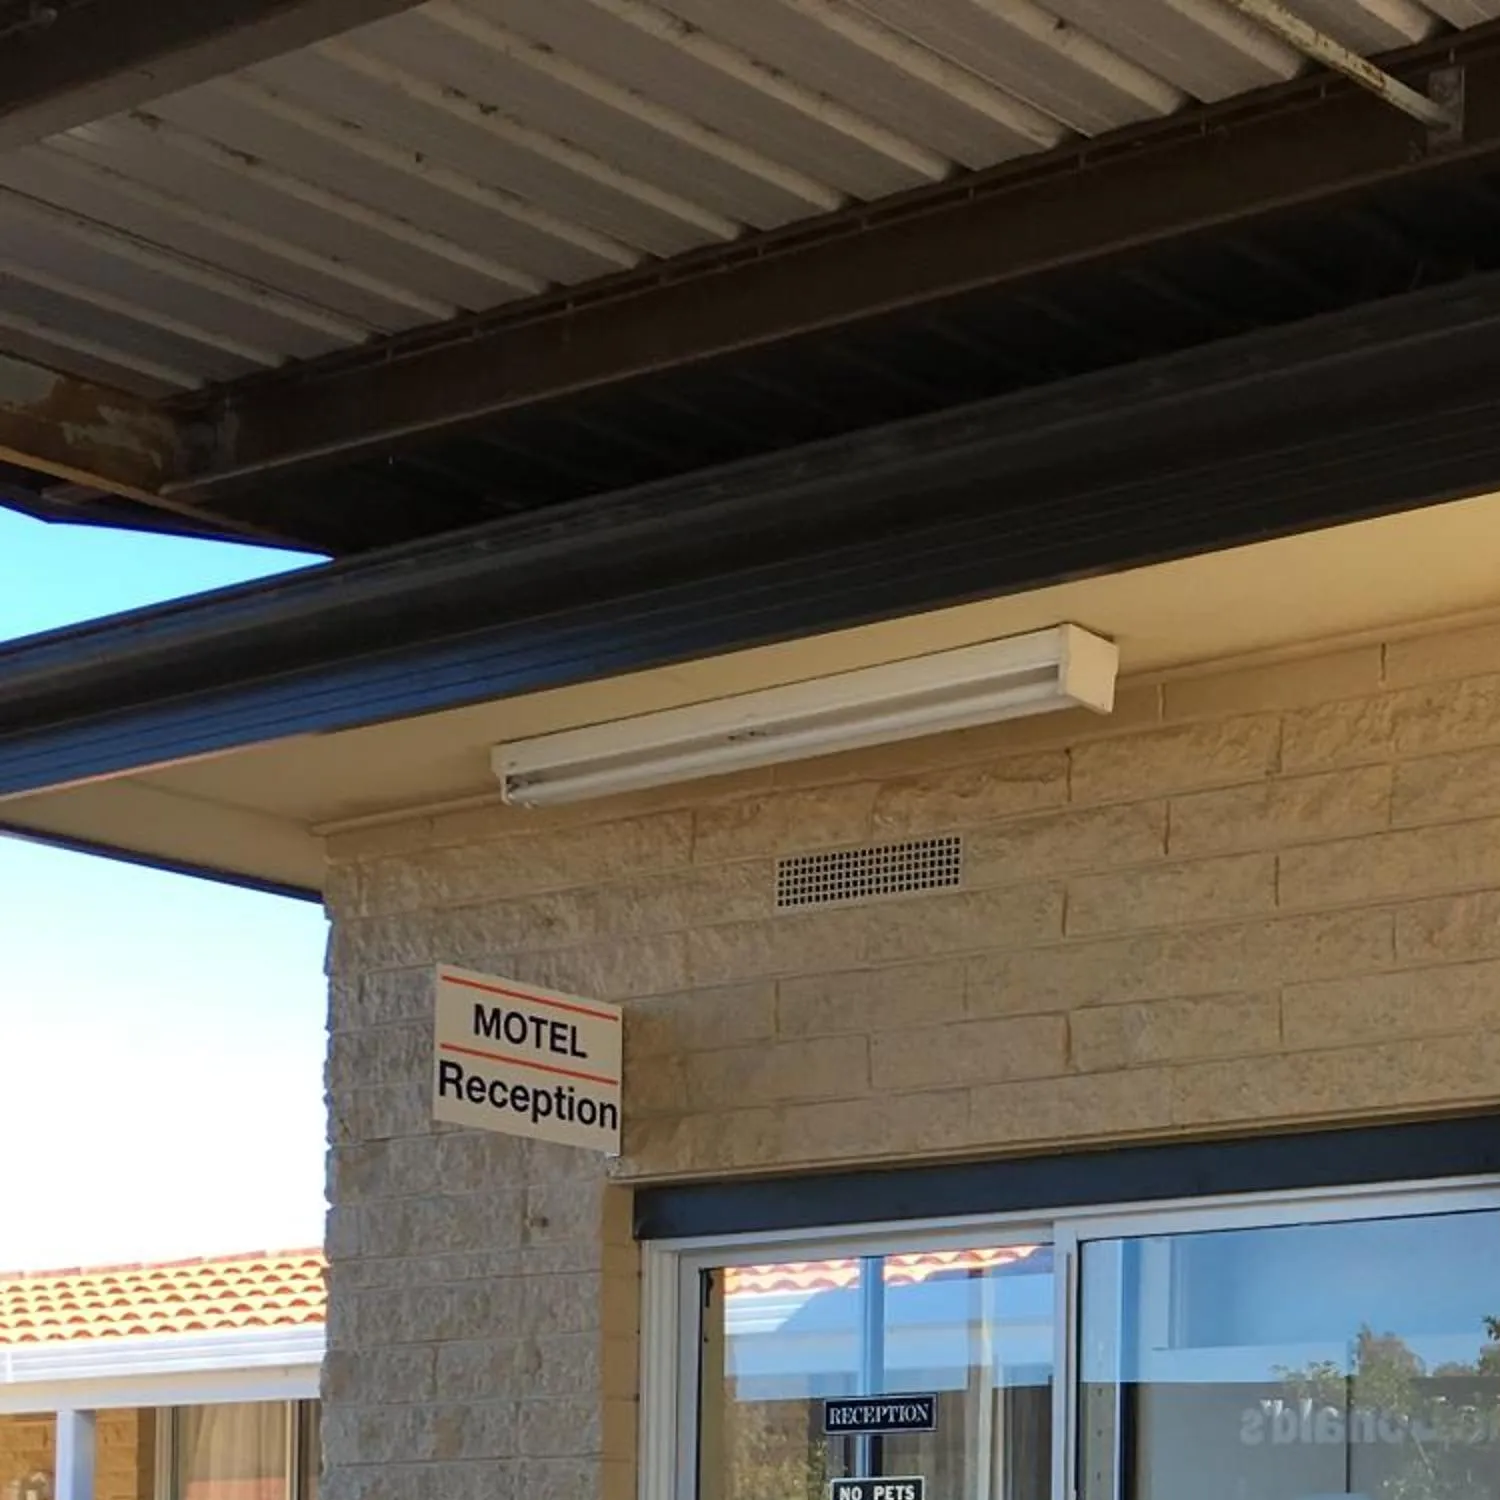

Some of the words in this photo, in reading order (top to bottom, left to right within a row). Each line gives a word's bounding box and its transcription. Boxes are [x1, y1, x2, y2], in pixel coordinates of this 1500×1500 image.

[474, 1003, 588, 1058] MOTEL
[438, 1059, 618, 1130] Reception
[829, 1403, 930, 1425] RECEPTION
